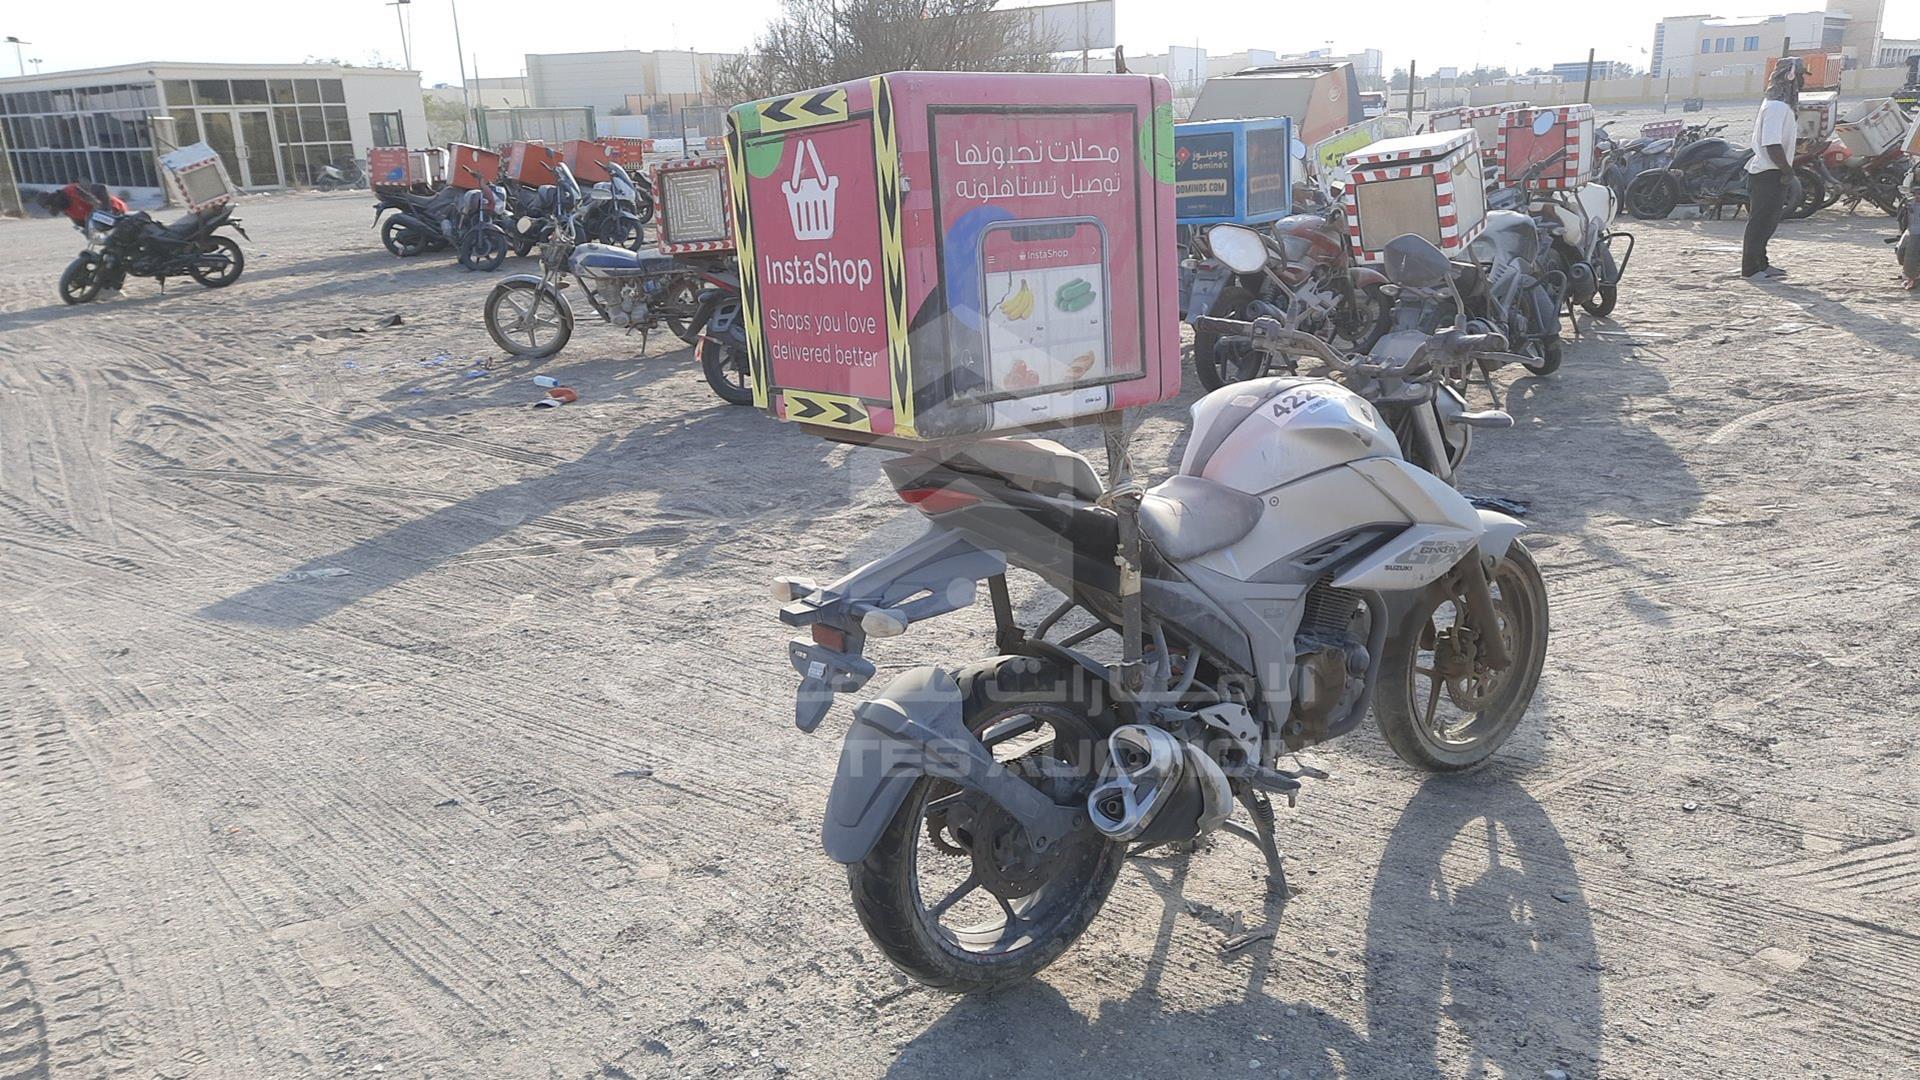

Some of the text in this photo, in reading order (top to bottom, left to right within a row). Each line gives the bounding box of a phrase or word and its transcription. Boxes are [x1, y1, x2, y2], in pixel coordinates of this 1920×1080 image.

[954, 137, 1120, 170] محلات تحبونها
[955, 172, 1121, 204] توصيل تستاهلونه
[1026, 247, 1069, 259] InstaShop
[765, 251, 873, 291] InstaShop
[769, 308, 877, 336] Shops you love
[772, 340, 879, 368] delivered better
